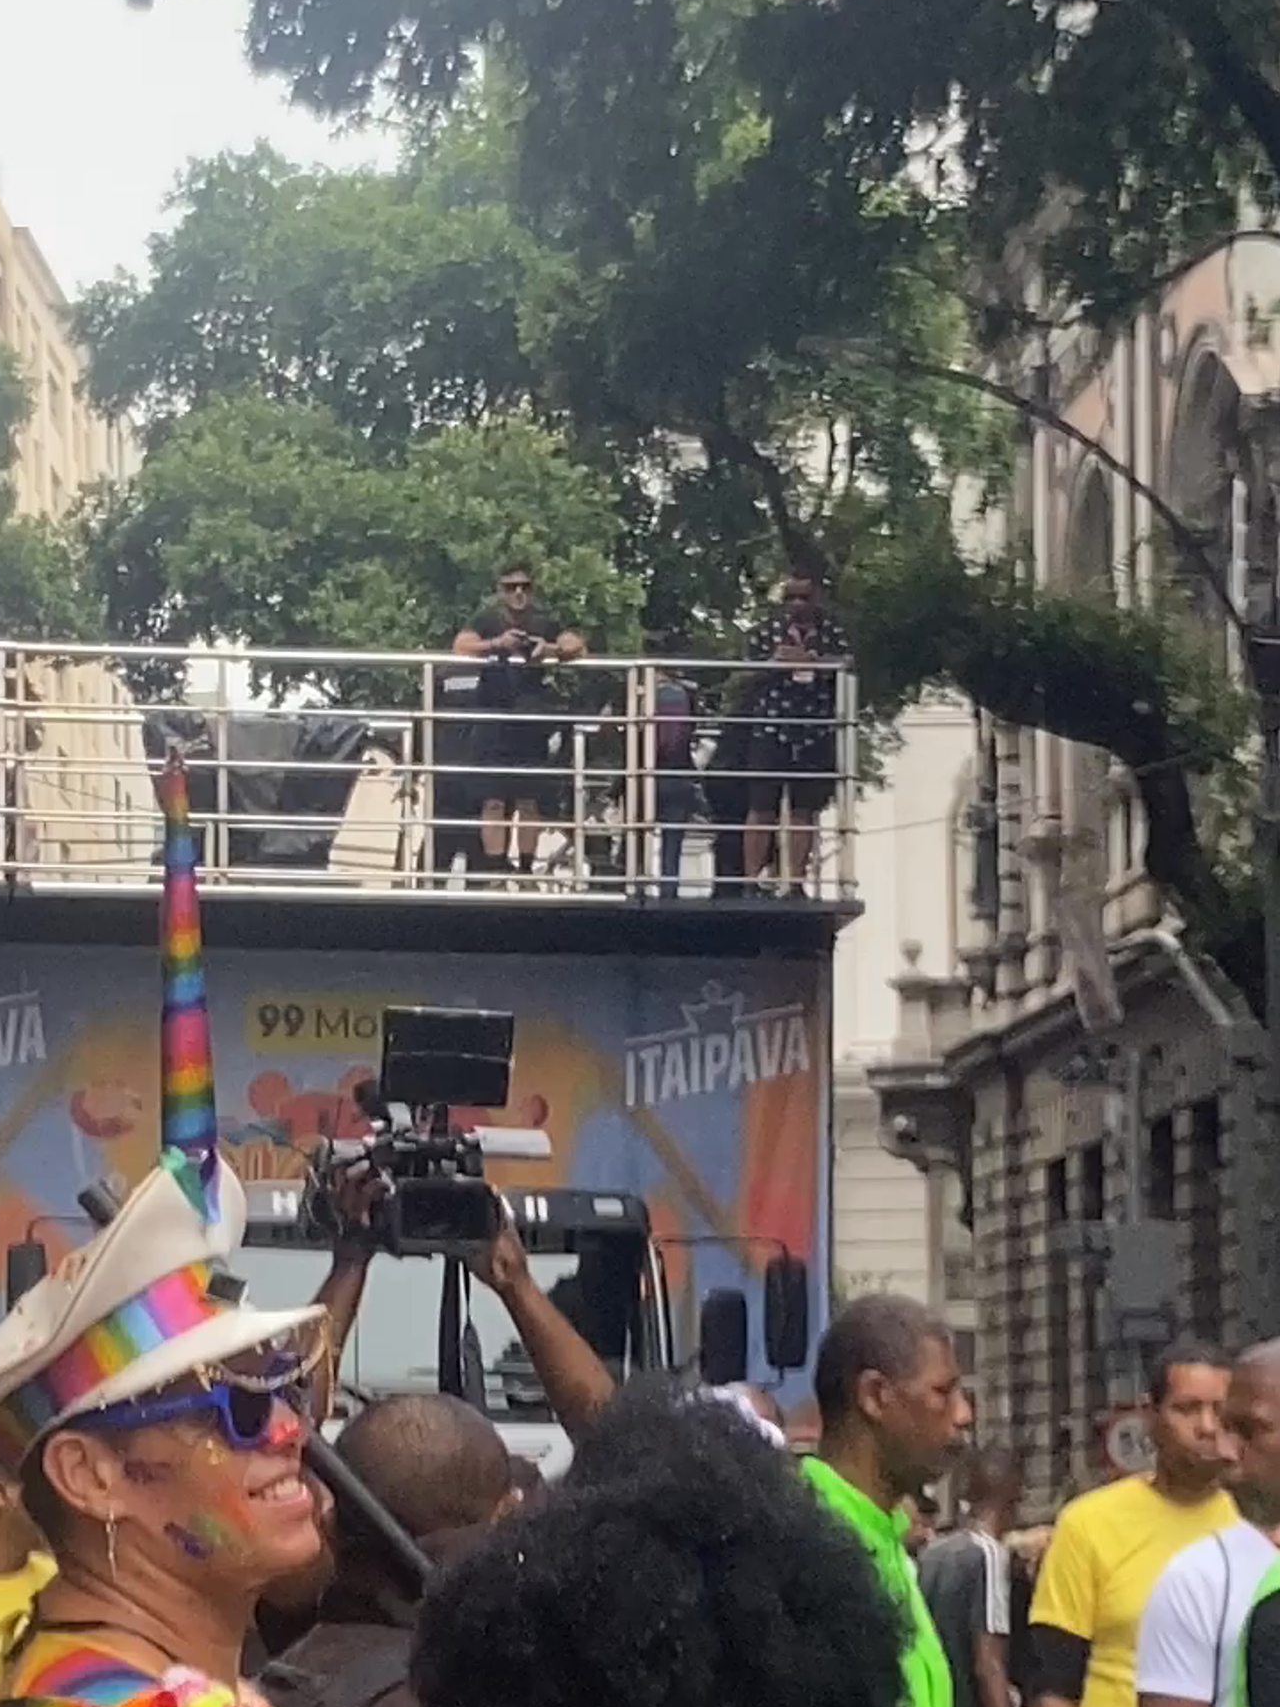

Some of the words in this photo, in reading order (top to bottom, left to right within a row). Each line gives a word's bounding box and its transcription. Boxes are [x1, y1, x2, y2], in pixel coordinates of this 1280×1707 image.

[259, 1003, 304, 1038] 99
[314, 1006, 378, 1039] Mo
[624, 1016, 811, 1109] ITAIPAVA
